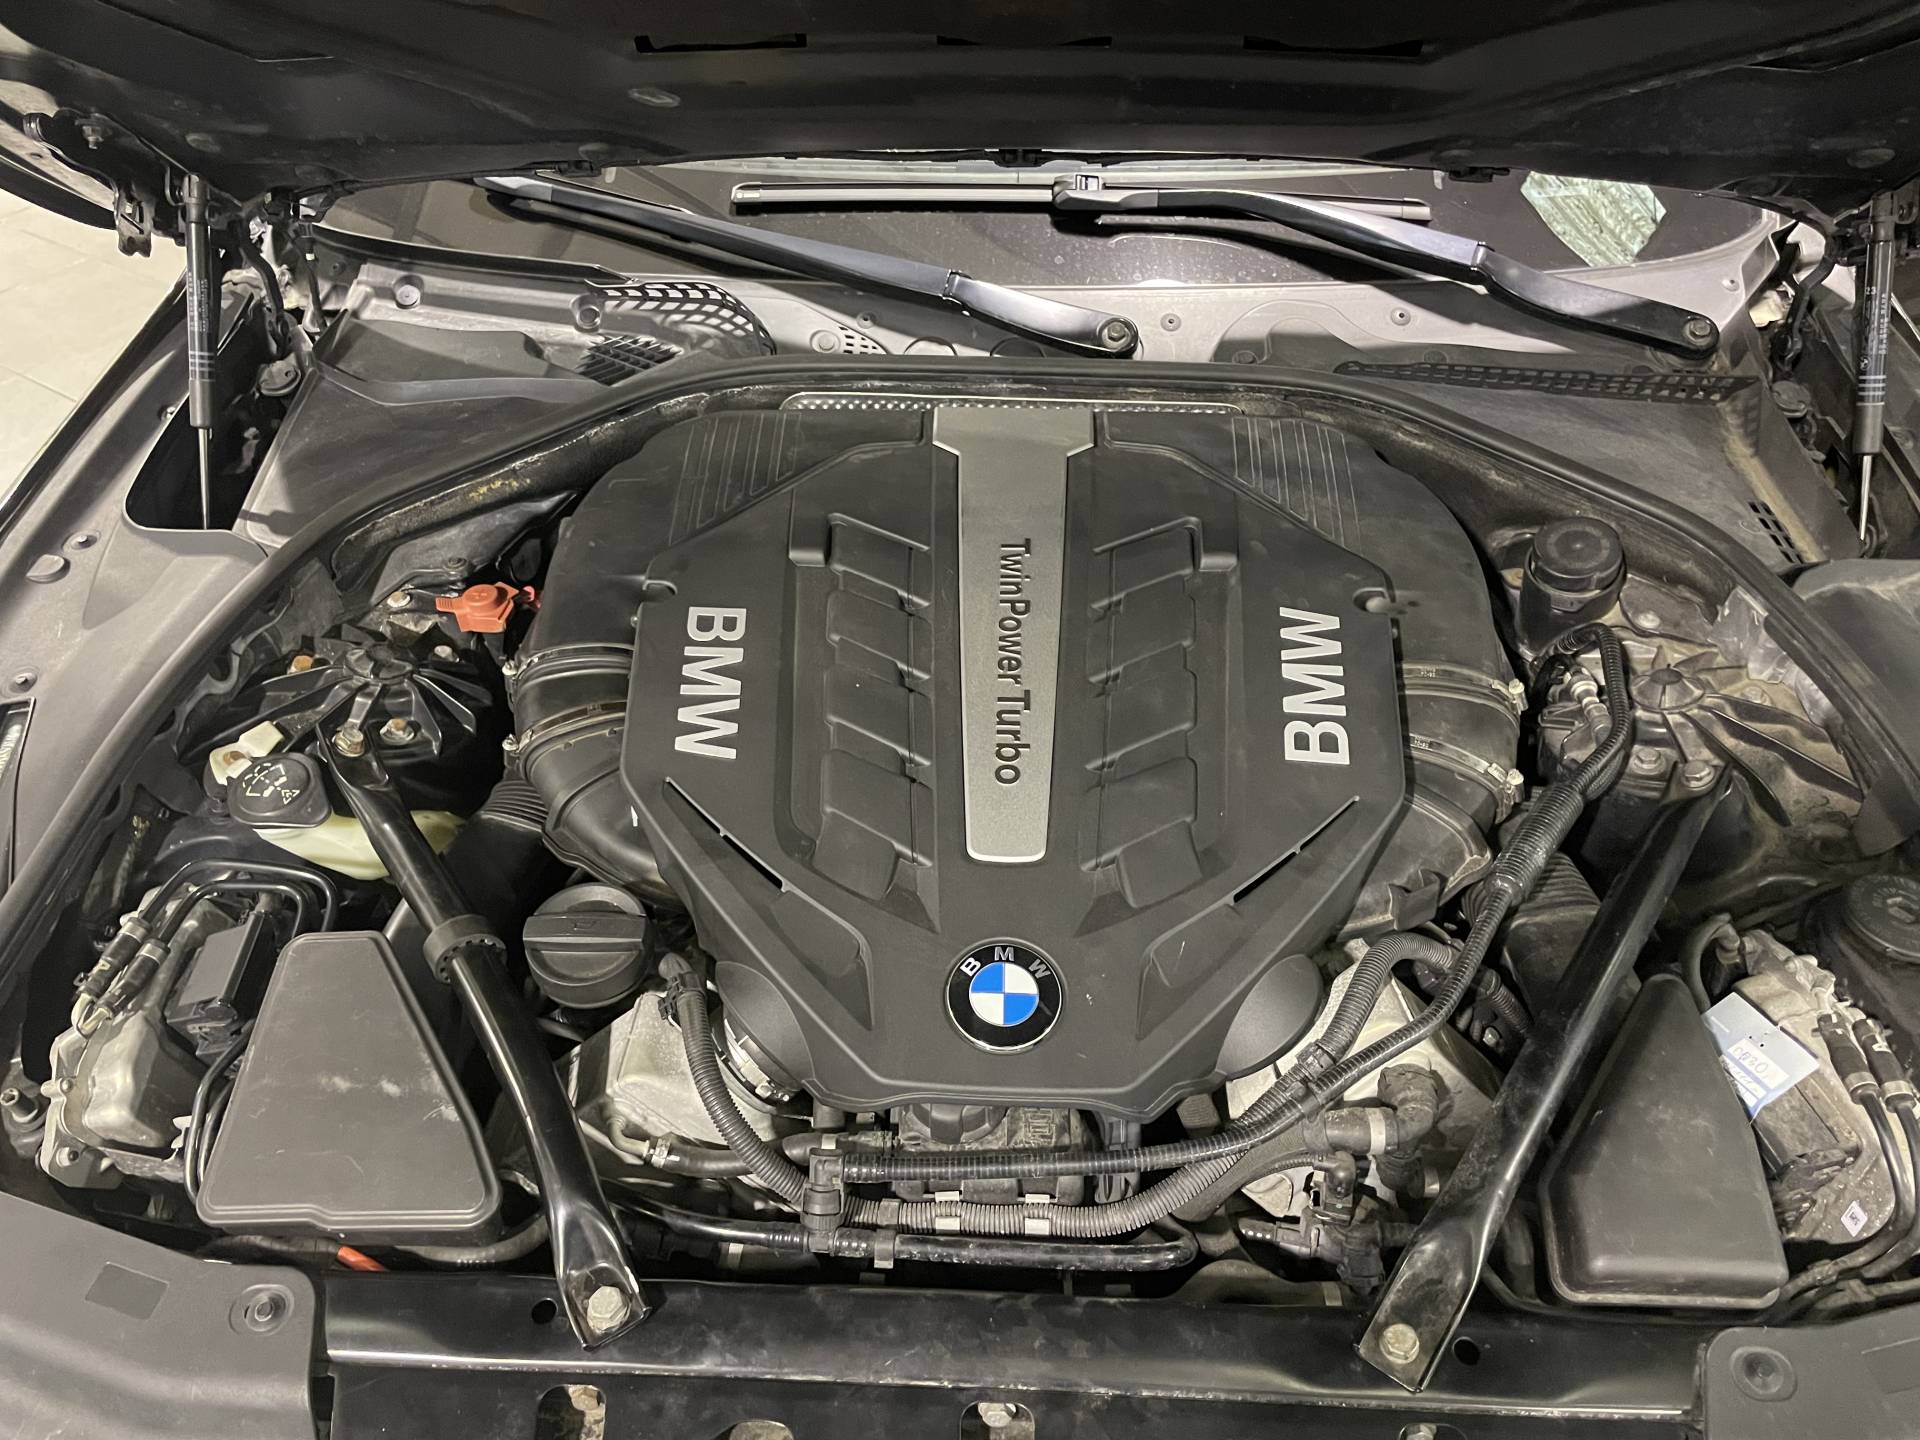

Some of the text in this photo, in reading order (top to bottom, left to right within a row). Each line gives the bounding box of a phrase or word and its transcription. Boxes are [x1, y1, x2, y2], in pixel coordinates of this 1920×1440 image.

[674, 606, 747, 760] BMW
[994, 689, 1031, 785] Turbo
[1279, 606, 1351, 765] BMW
[959, 946, 1052, 979] BMW
